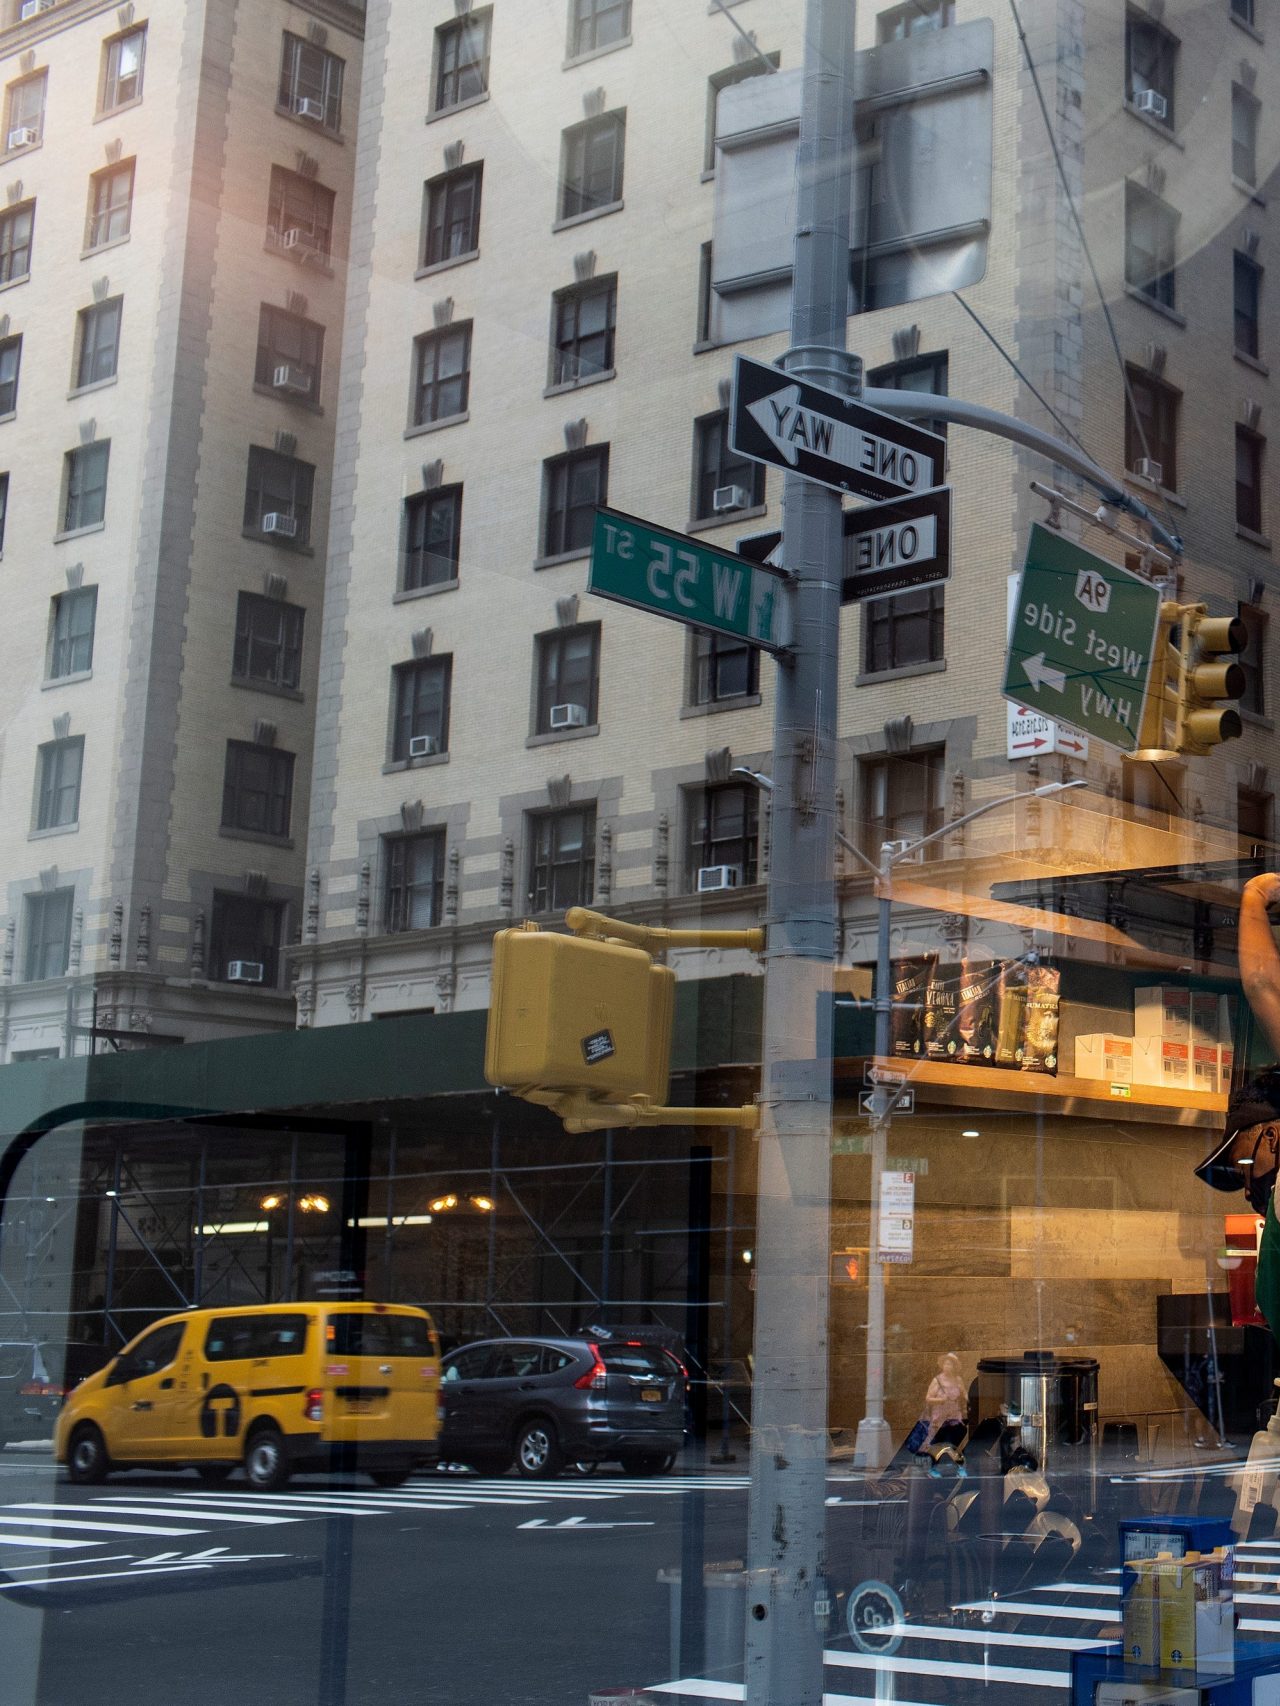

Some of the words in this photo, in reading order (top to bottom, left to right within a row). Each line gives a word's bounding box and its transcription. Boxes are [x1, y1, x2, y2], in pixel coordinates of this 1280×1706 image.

[926, 990, 954, 1006] VERONA
[960, 984, 983, 1001] ITALIAN
[1026, 1001, 1059, 1010] SUMATRA
